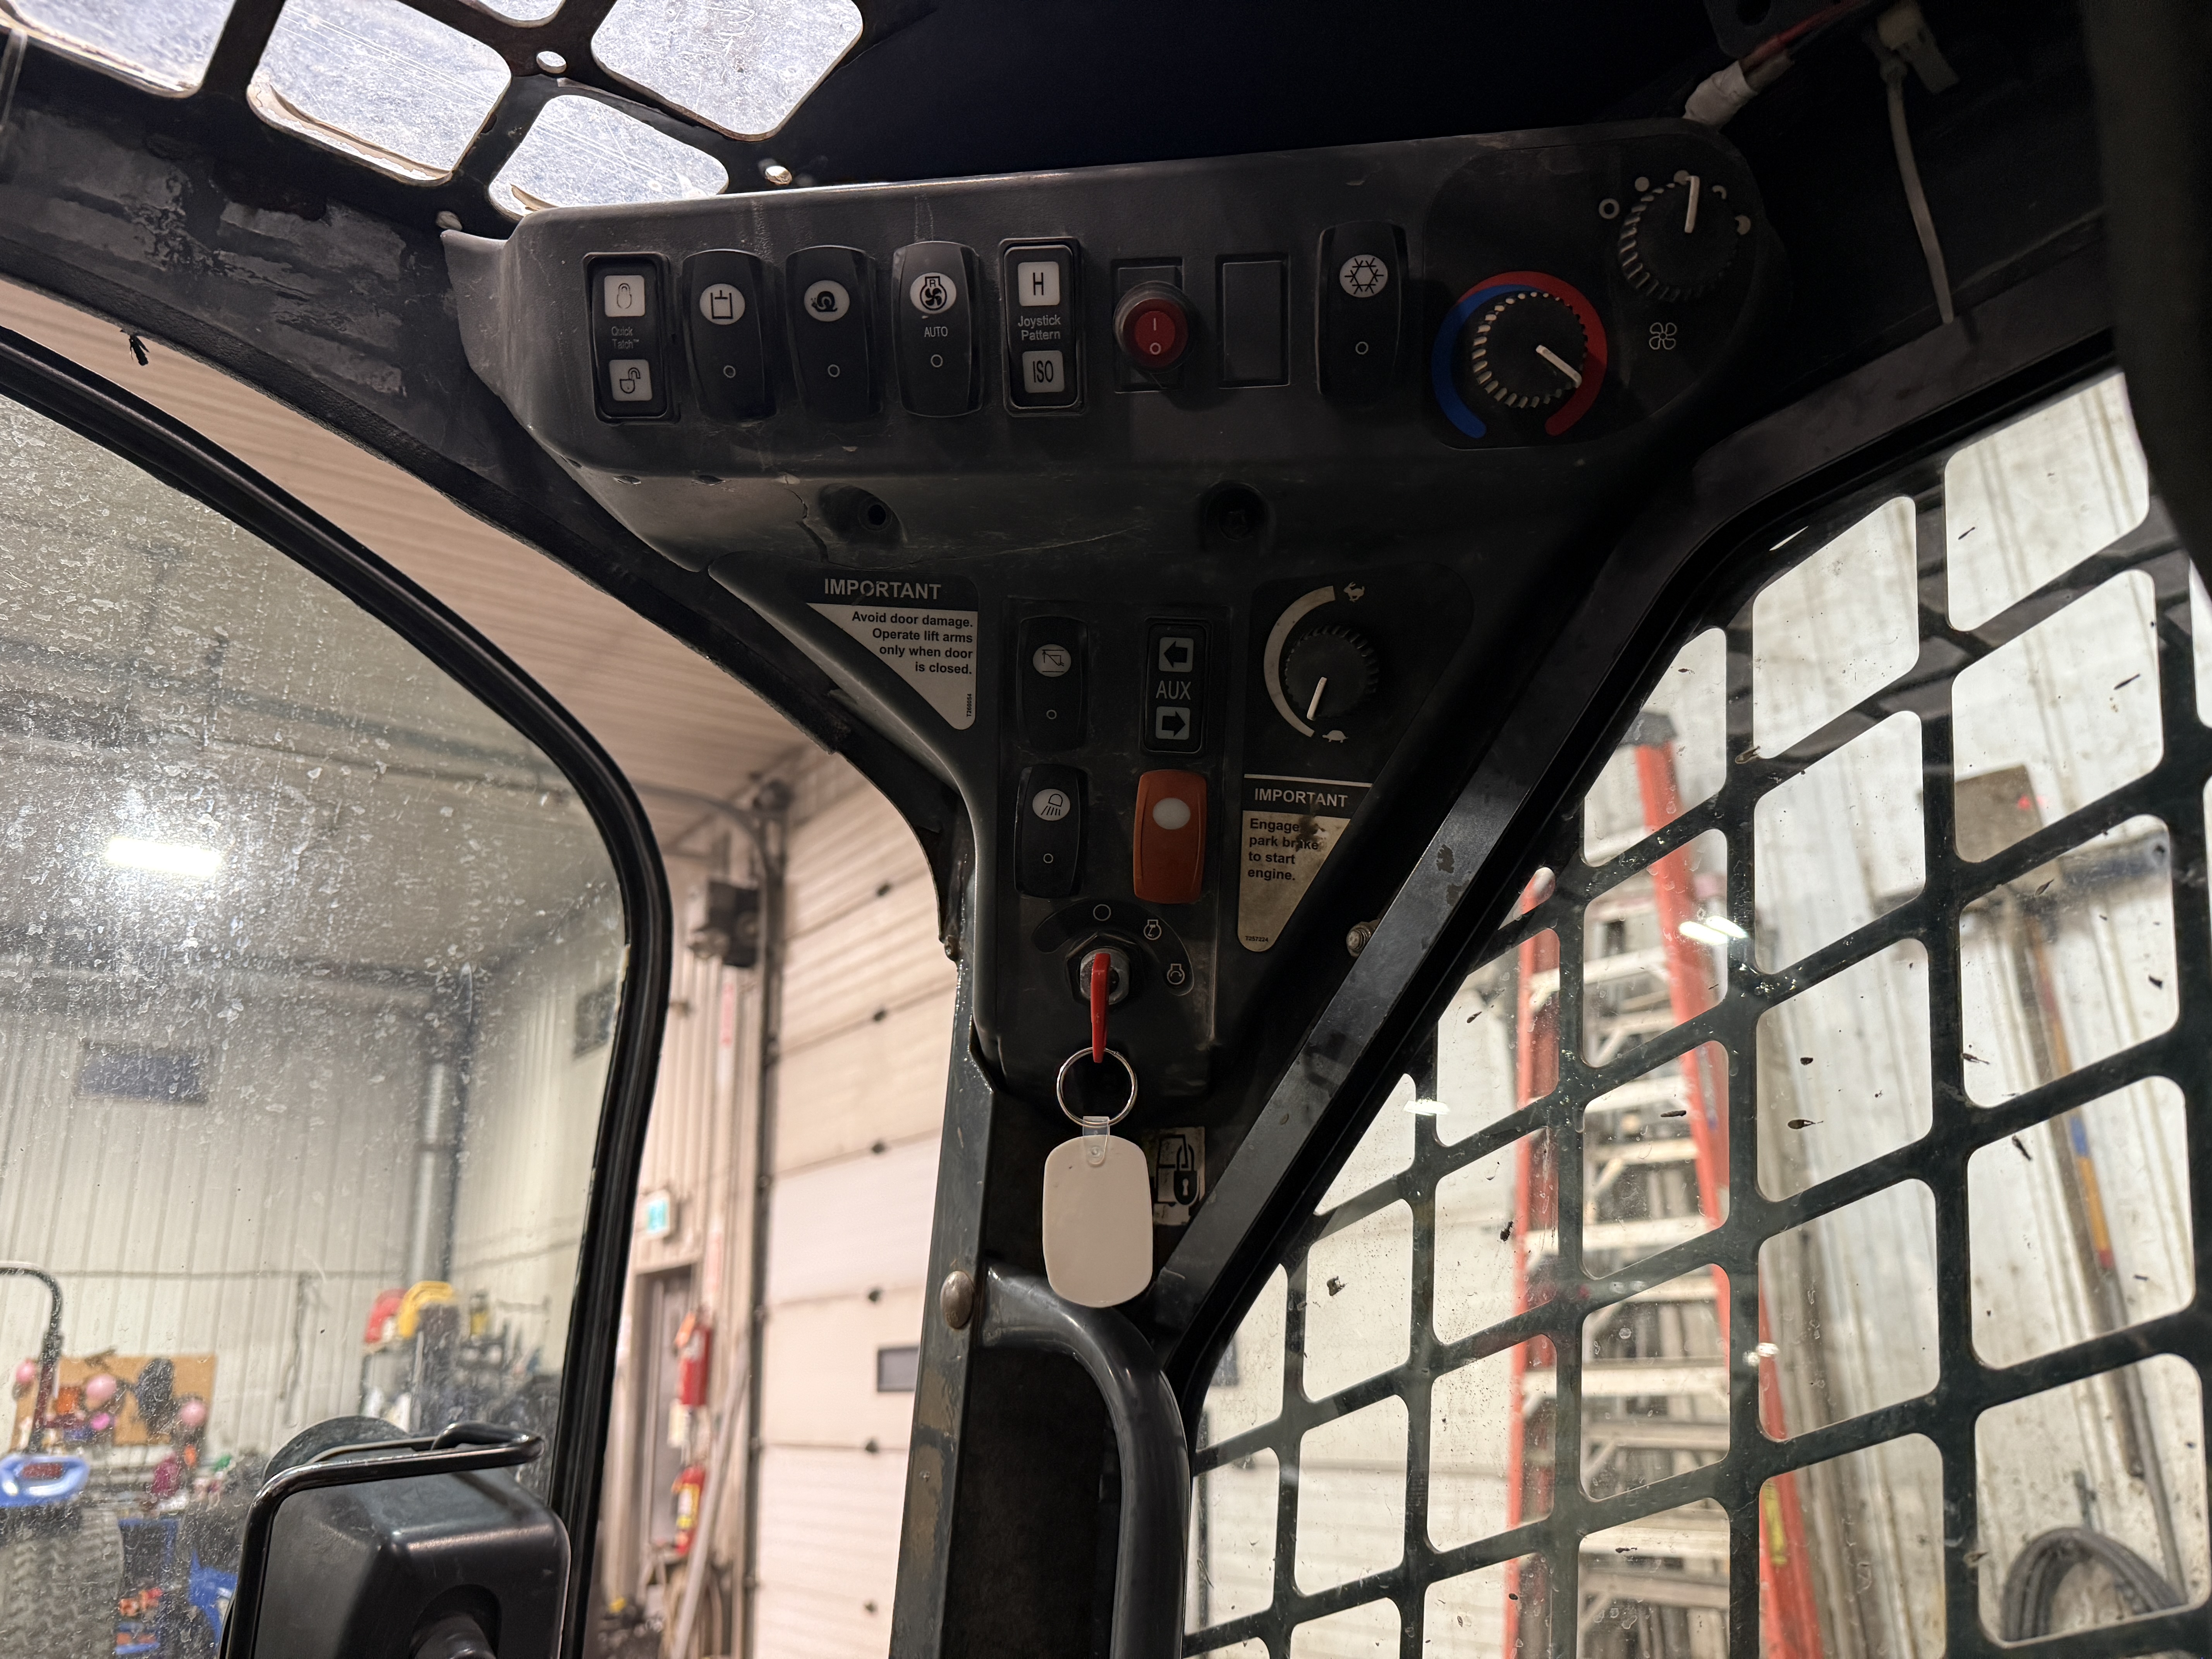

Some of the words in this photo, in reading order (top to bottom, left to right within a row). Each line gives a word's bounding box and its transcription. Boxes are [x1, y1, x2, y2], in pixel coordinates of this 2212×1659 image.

[1033, 272, 1044, 295] H
[1018, 314, 1061, 328] Joystick
[611, 326, 633, 336] Quick
[924, 326, 948, 337] AUTO
[1021, 327, 1060, 340] Pattern
[1033, 360, 1054, 383] ISO
[824, 578, 941, 599] IMPORTANT
[852, 611, 886, 623] Avoid
[890, 613, 919, 624] door
[922, 615, 973, 629] damage.
[872, 628, 920, 641] Operate
[924, 630, 939, 641] lift
[943, 634, 973, 643] arms
[879, 645, 905, 658] only
[909, 646, 941, 657] when
[945, 647, 973, 659] door
[915, 661, 925, 672] is
[929, 663, 972, 674] closed.
[1156, 680, 1191, 700] AUX
[1255, 788, 1348, 807] IMPORTANT
[1250, 818, 1299, 834] Engage
[1249, 835, 1278, 848] park
[1248, 851, 1261, 862] to
[1265, 853, 1295, 864] start
[1248, 868, 1295, 881] engine.
